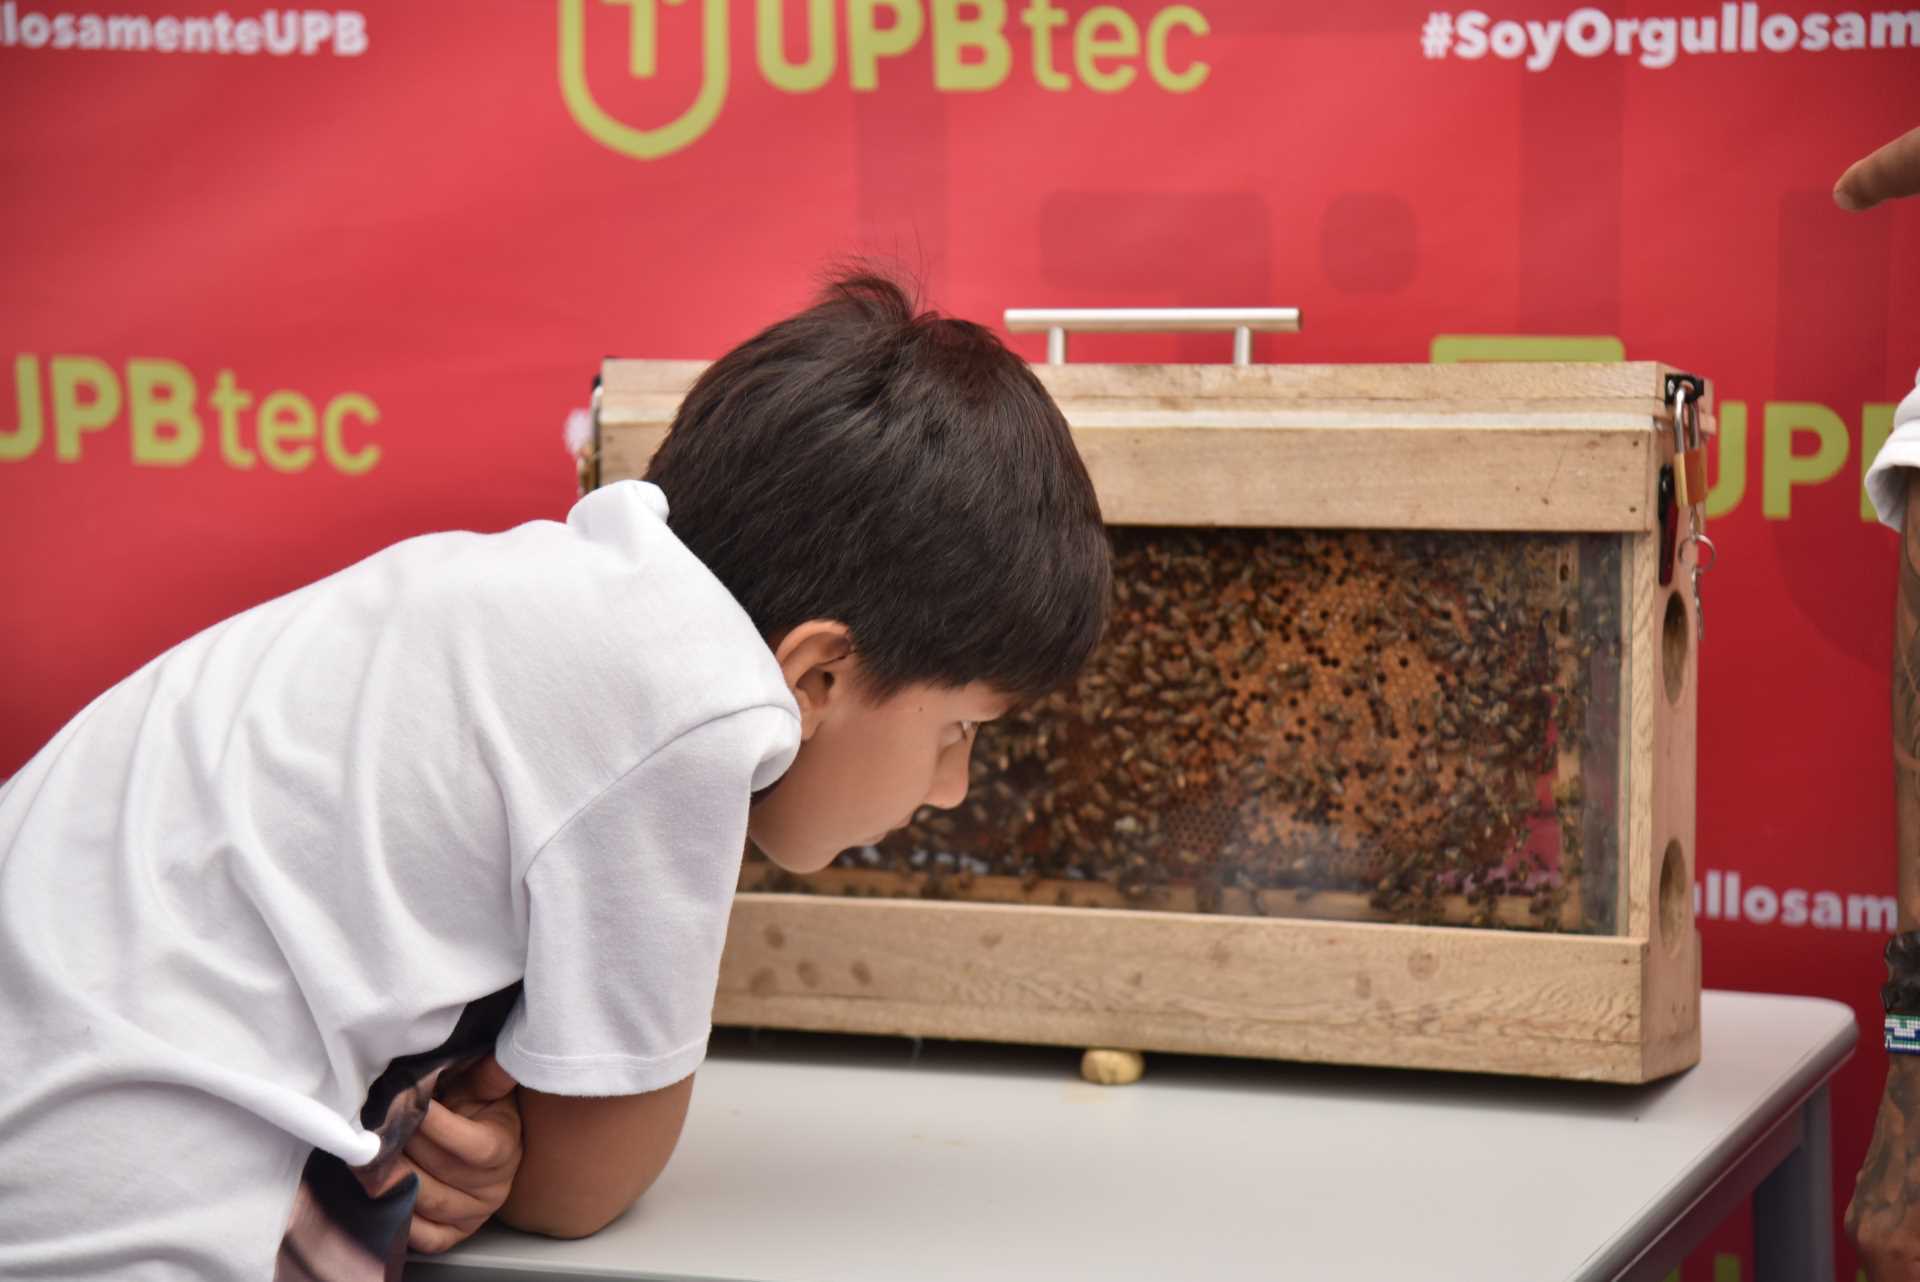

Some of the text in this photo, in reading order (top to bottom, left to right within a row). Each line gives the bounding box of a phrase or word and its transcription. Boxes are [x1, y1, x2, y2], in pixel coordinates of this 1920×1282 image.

[0, 1, 368, 56] losamenteUPB
[755, 0, 1211, 92] UPBtec
[1420, 2, 1920, 71] #SoyOrgullosam
